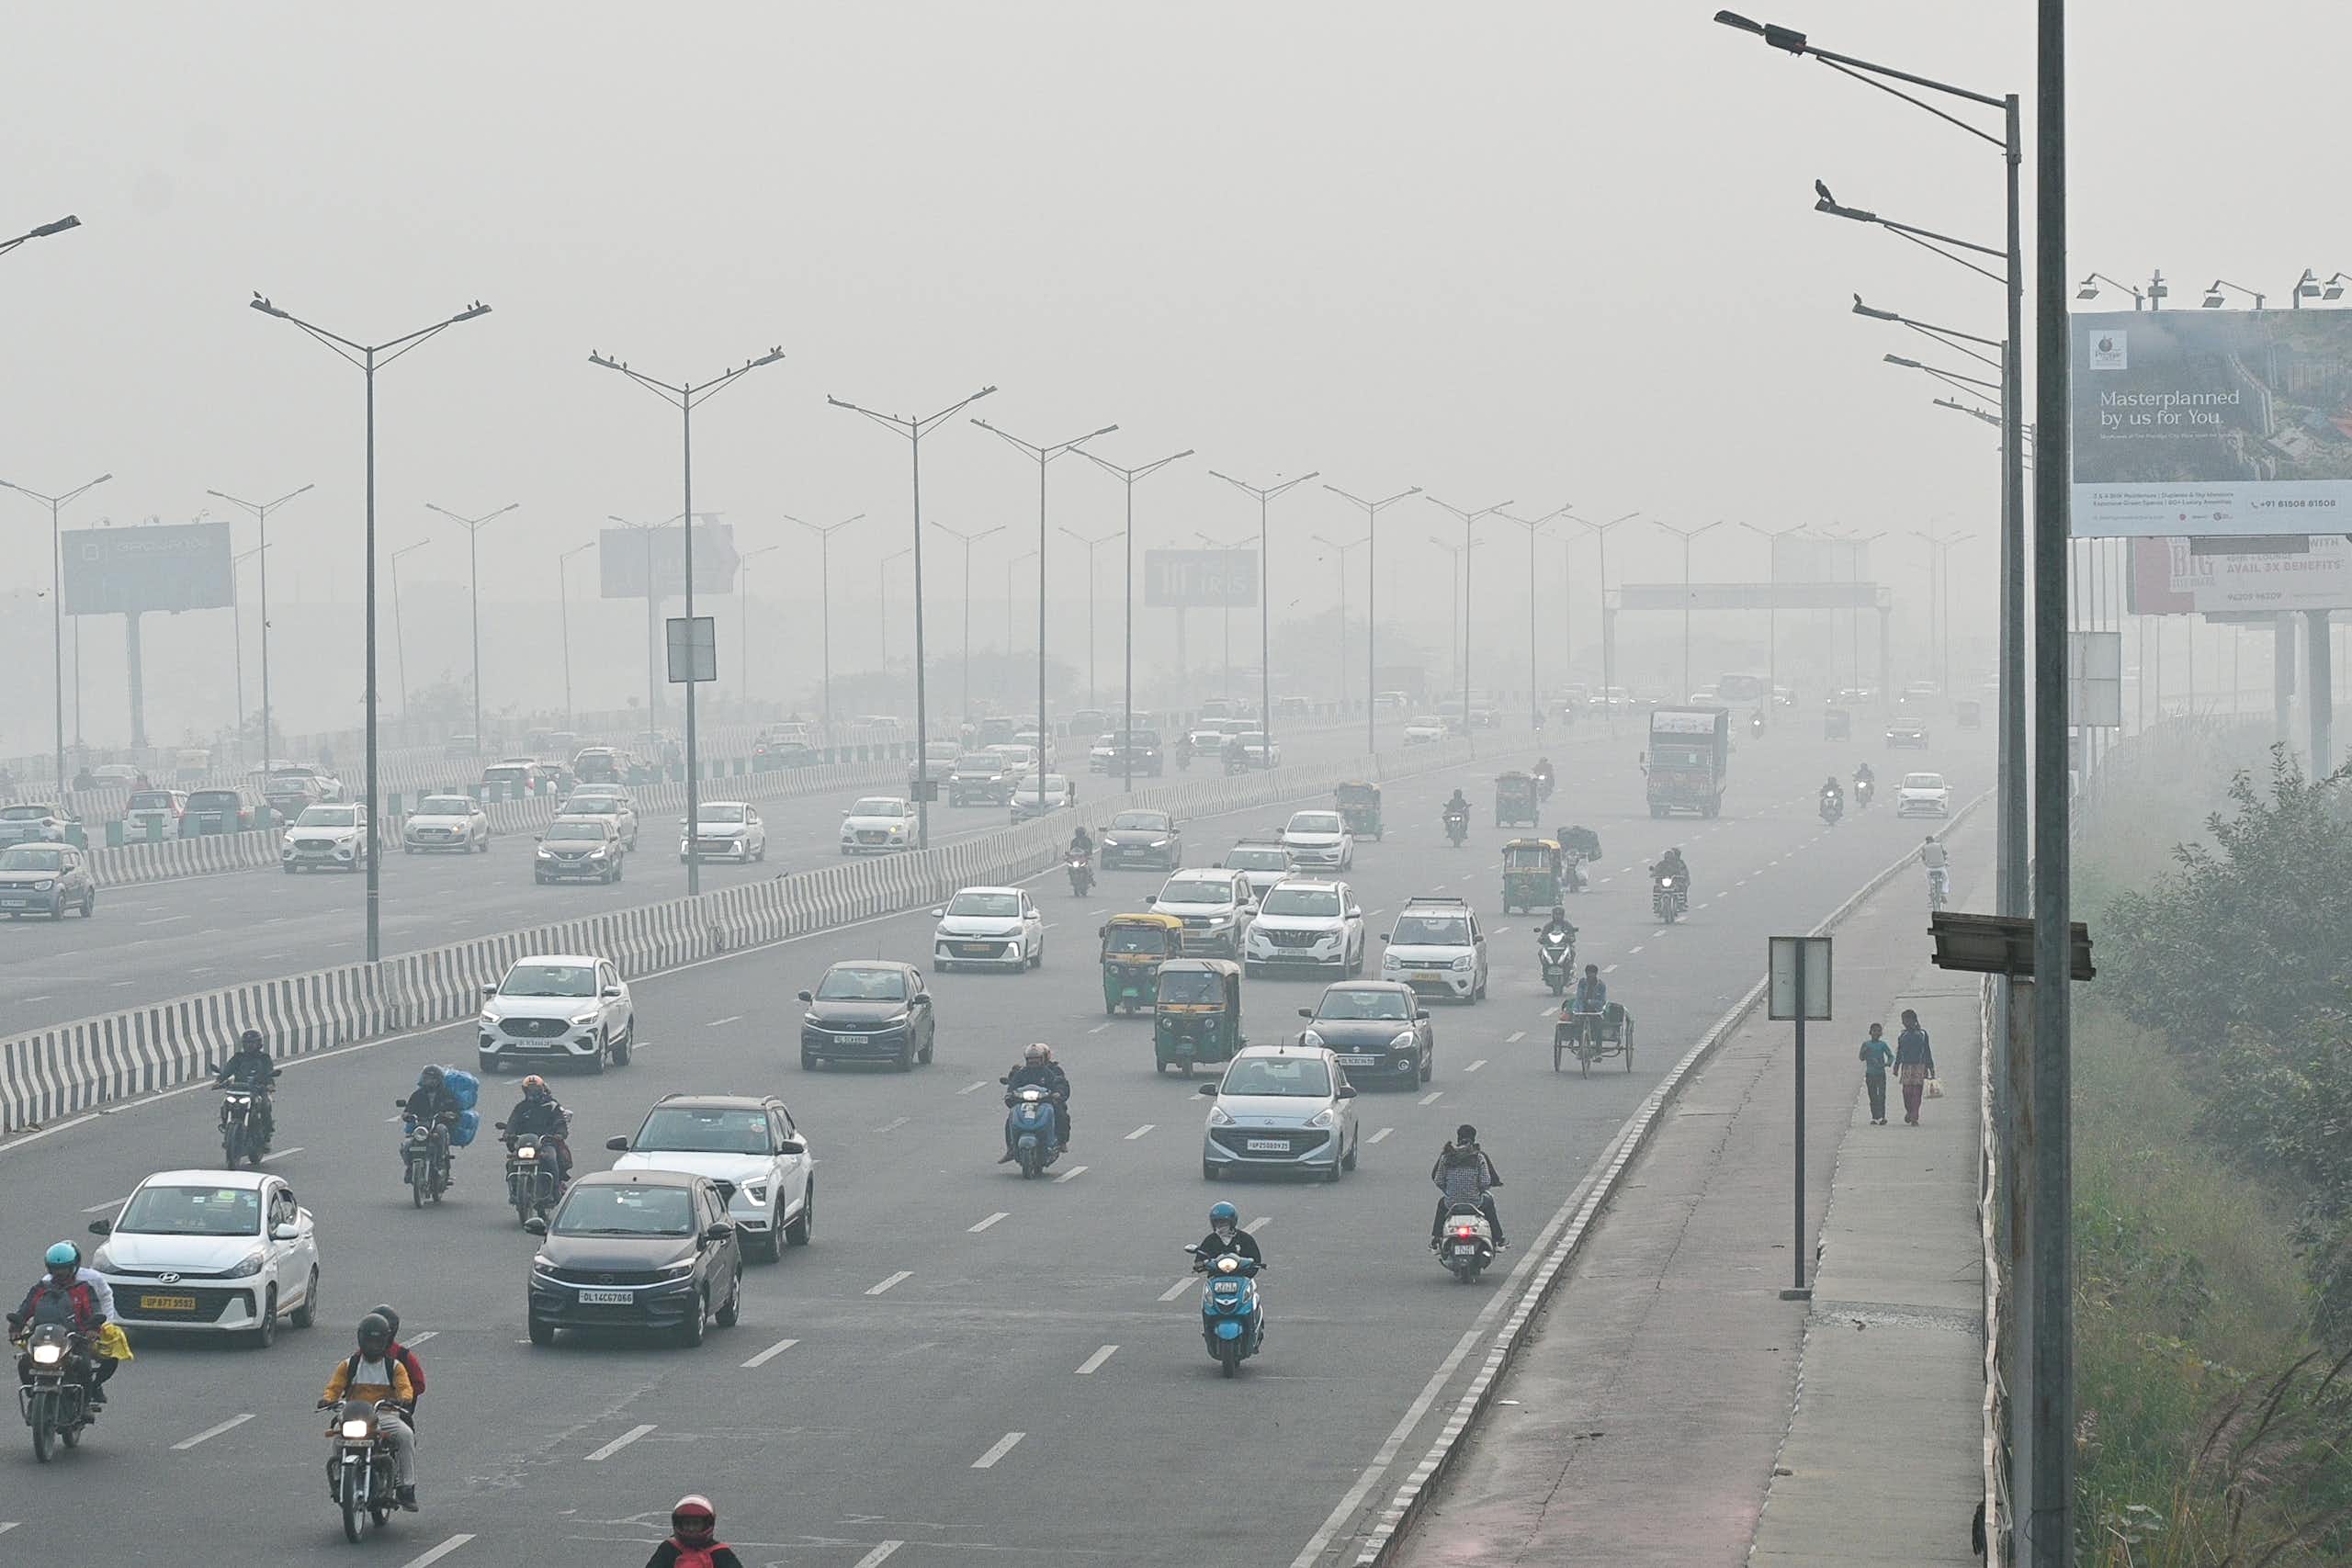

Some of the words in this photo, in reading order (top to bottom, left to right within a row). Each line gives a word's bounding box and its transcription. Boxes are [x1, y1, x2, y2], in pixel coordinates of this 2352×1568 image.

[2100, 389, 2240, 410] Masterplanned
[2100, 410, 2123, 430] by
[2130, 412, 2153, 425] us
[2157, 410, 2183, 425] for
[2188, 409, 2224, 425] You.
[2226, 563, 2261, 573] AVAIL
